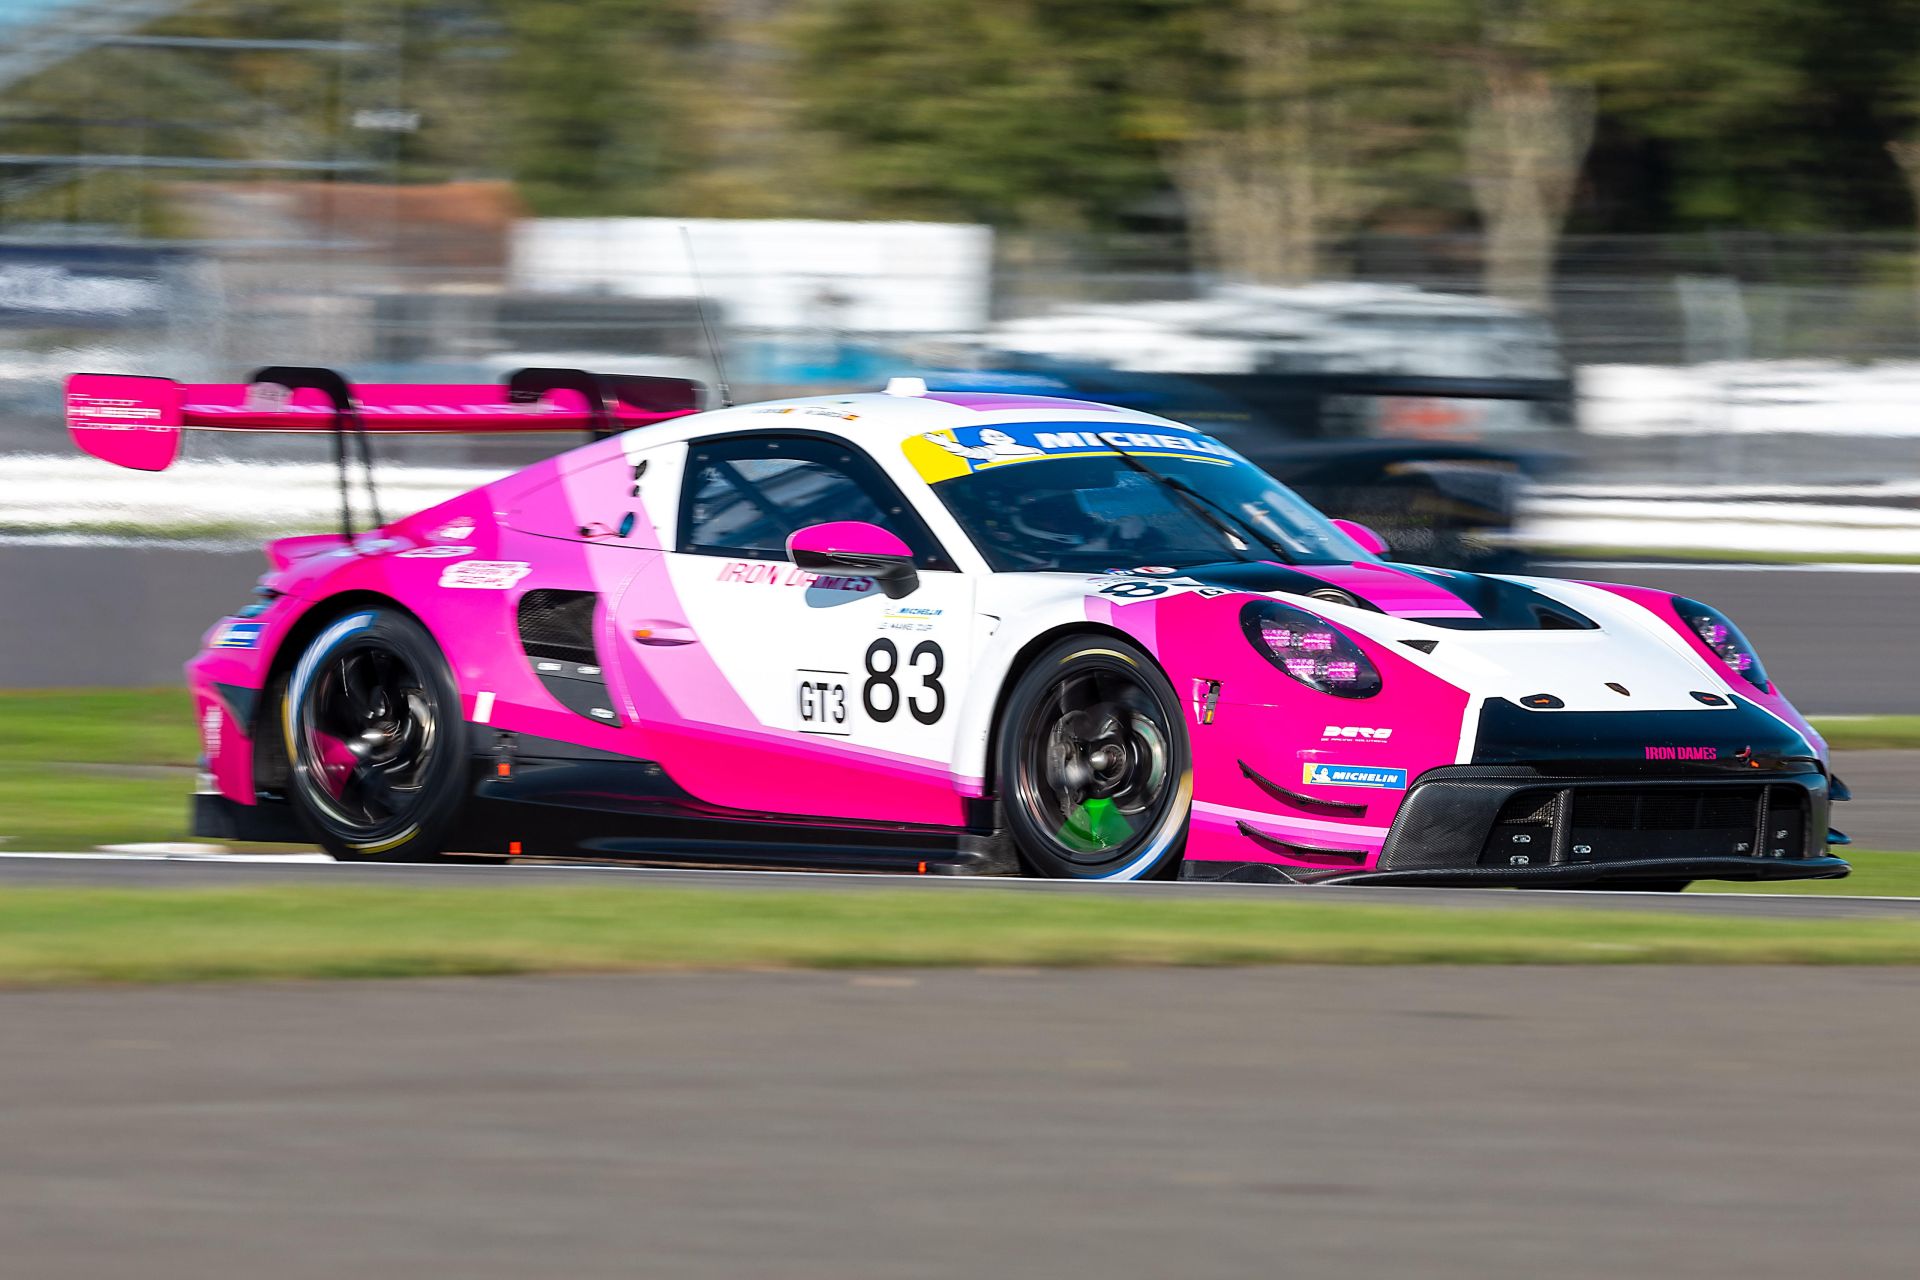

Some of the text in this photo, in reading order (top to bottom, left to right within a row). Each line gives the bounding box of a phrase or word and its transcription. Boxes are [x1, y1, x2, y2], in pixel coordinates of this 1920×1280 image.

[716, 563, 783, 585] IRON
[862, 637, 946, 726] 83
[800, 681, 846, 724] GT3
[1645, 746, 1717, 760] IRON DAMES
[1332, 771, 1398, 783] MICHELIN
